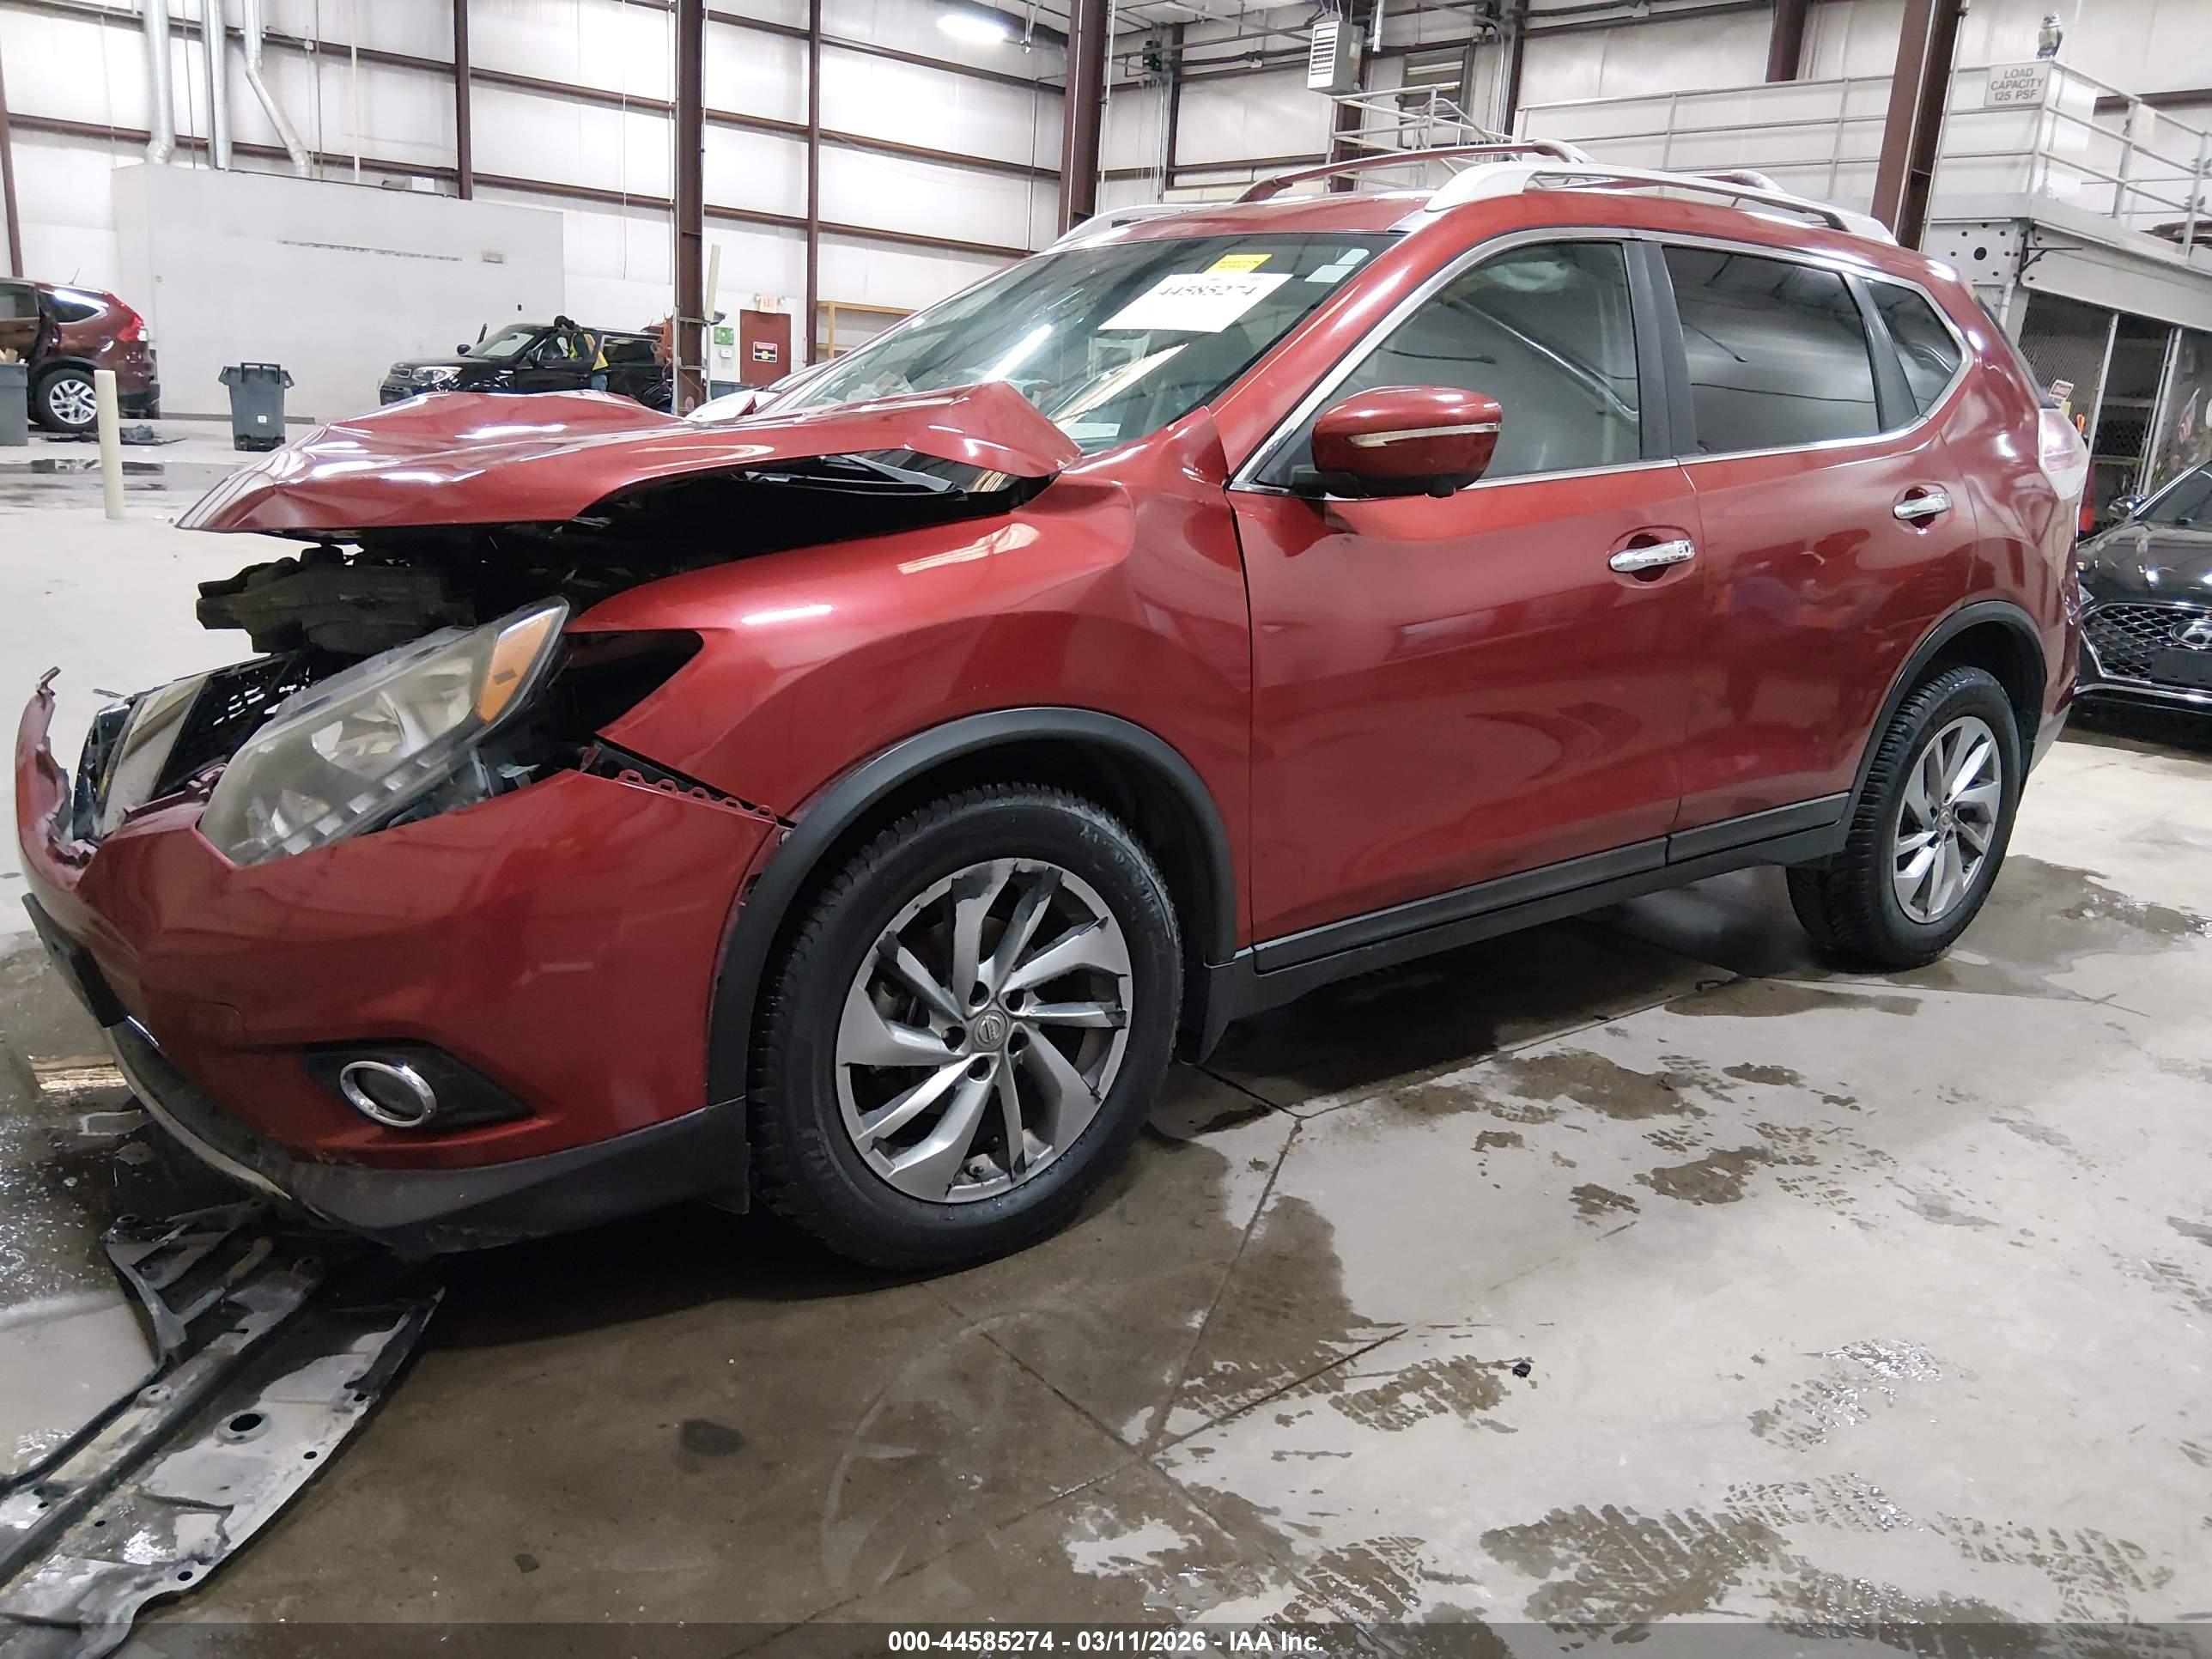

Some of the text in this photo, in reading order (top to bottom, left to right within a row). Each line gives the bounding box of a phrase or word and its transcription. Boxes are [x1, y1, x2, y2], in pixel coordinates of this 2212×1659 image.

[2004, 68, 2033, 79] LOAD
[1990, 77, 2045, 90] CAPACITY
[1994, 88, 2038, 101] 125 PSF
